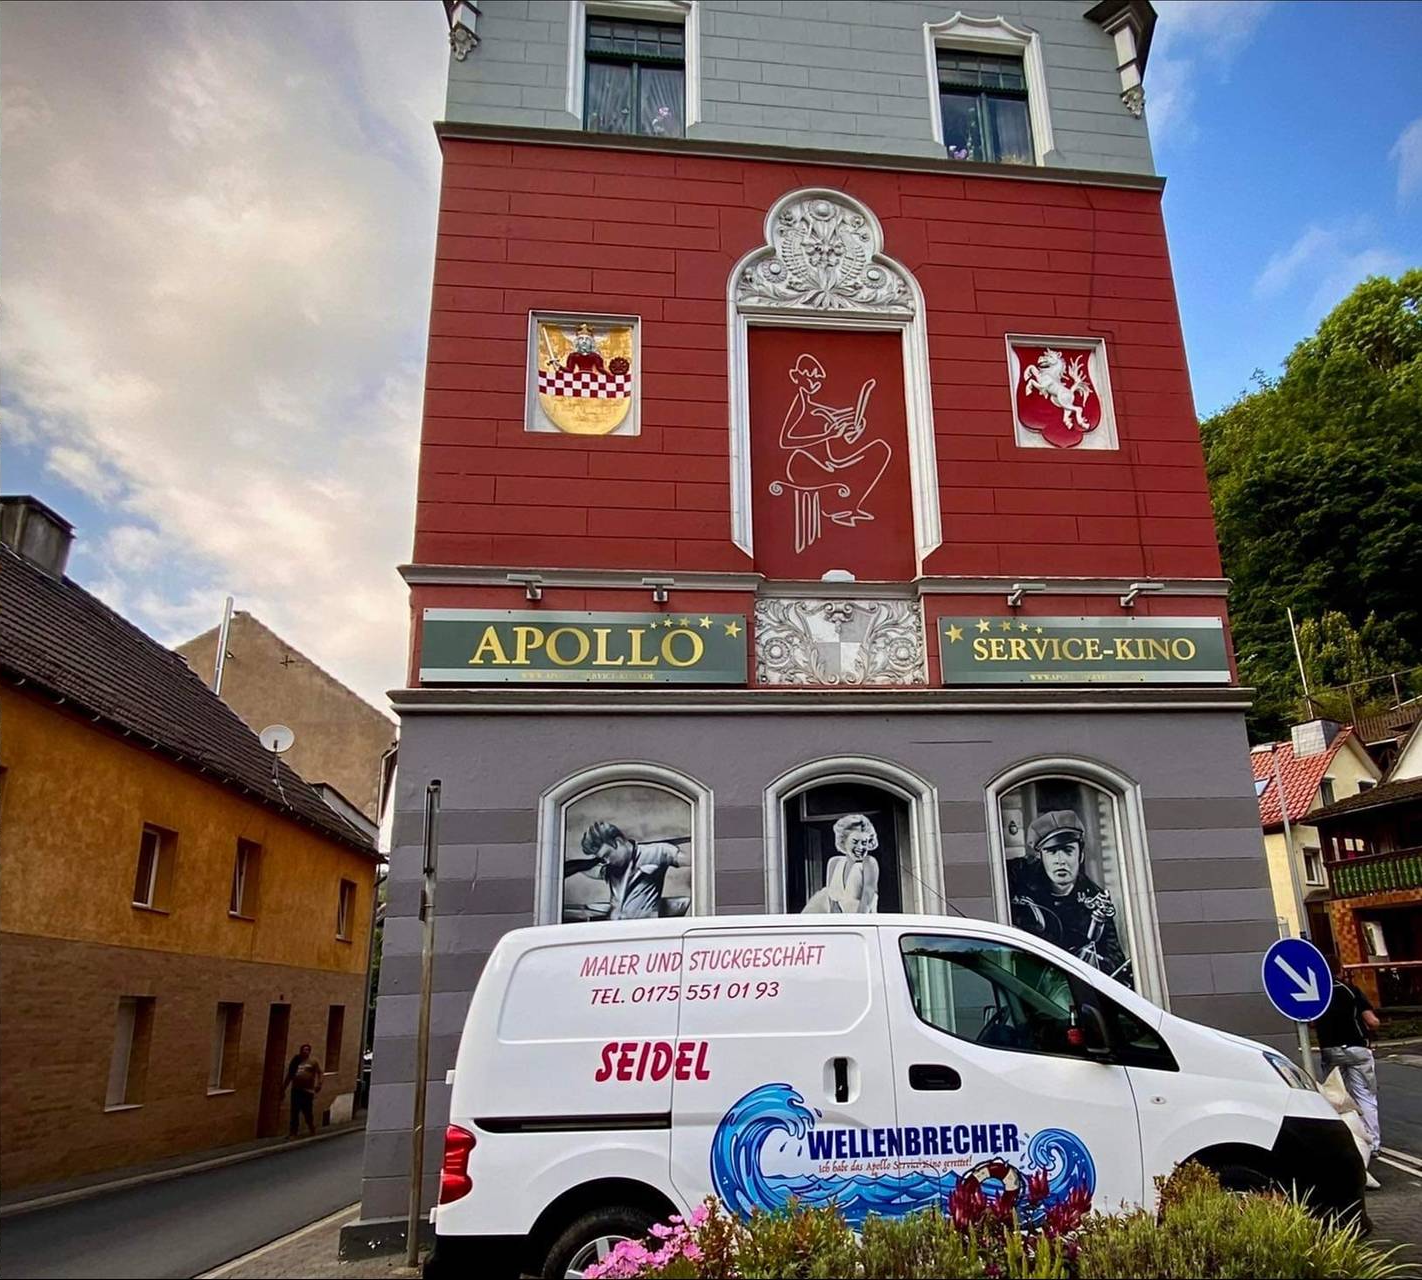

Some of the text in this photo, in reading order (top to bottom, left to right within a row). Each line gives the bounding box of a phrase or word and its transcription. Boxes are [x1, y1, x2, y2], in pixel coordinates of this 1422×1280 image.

[468, 625, 705, 667] APOLLO
[972, 637, 1196, 662] SERVICE-KINO
[579, 942, 826, 977] MALER UND STUCKGESCHÄFT
[590, 981, 780, 1005] TEL. 0175 551 01 93
[595, 1041, 711, 1082] SEIDEL
[807, 1123, 1020, 1160] WELLENBRECHER
[818, 1160, 831, 1173] Ich
[832, 1160, 848, 1173] habe
[850, 1159, 863, 1172] das
[865, 1158, 891, 1174] Apollo
